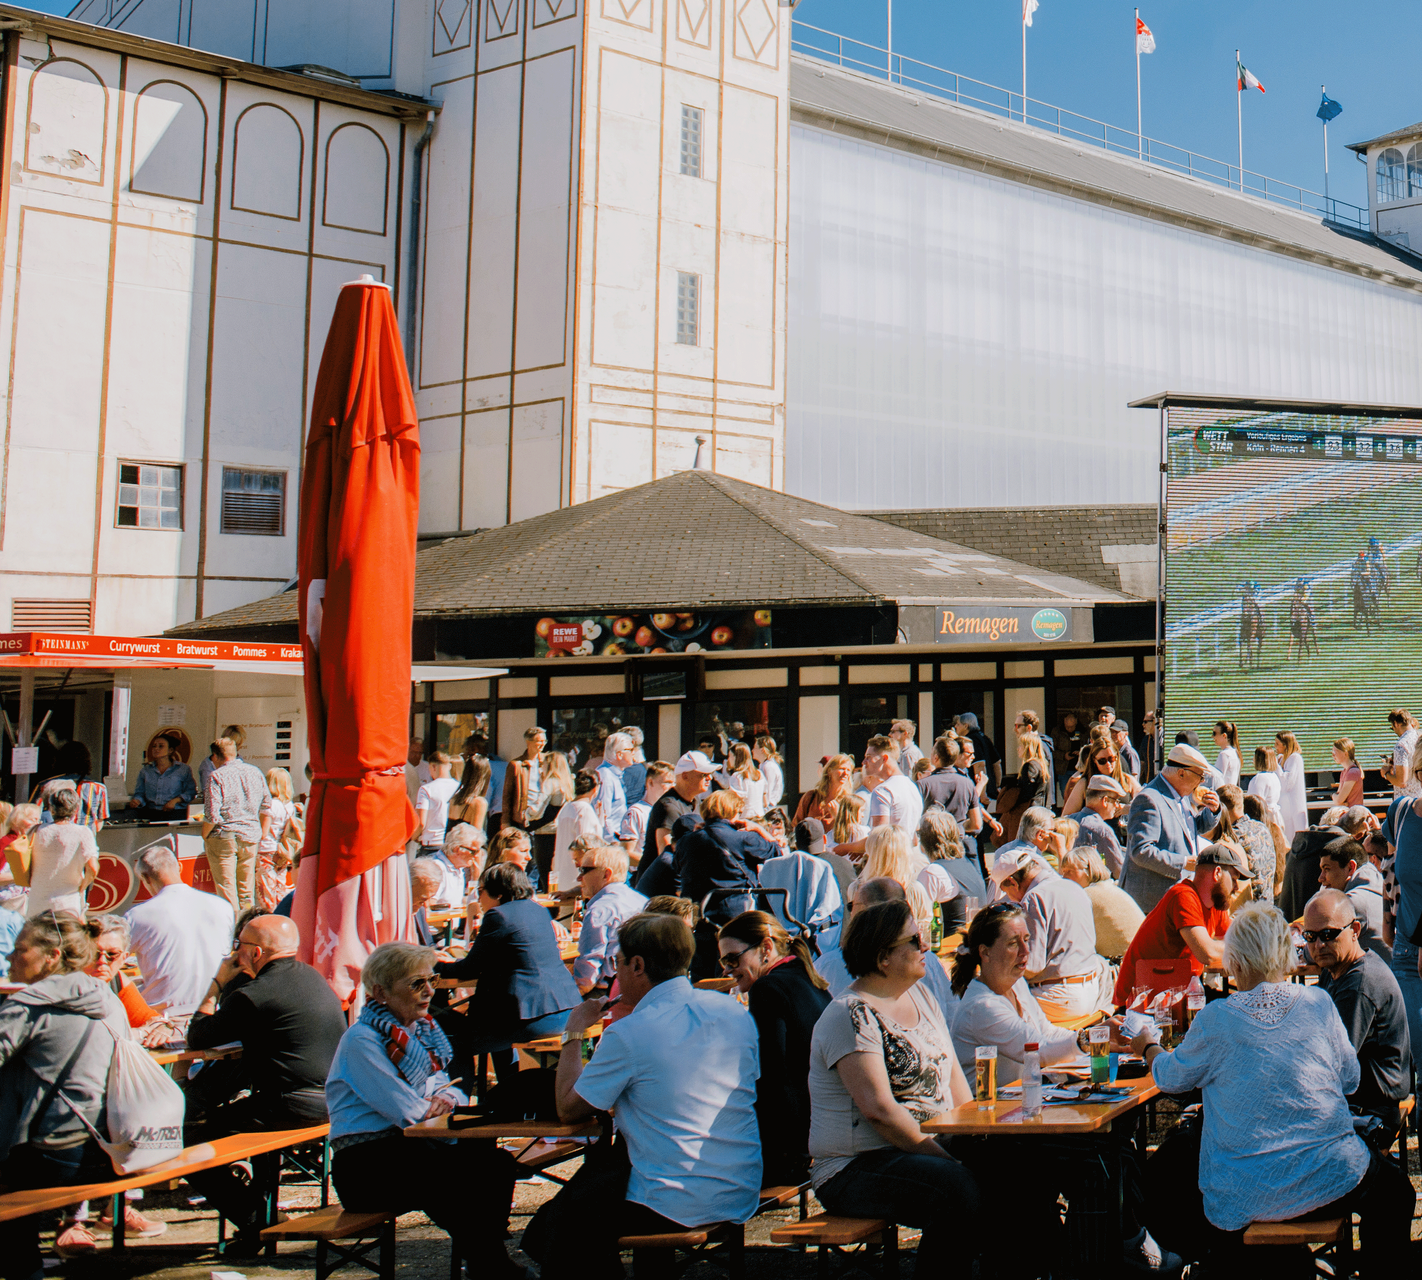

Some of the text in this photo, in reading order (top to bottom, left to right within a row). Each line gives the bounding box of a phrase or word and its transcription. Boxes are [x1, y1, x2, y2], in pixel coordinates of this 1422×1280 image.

[1202, 430, 1229, 440] WETT
[1209, 441, 1234, 452] STAR
[940, 610, 1018, 641] Remagen
[1035, 620, 1063, 632] Remagen
[553, 628, 578, 636] REWE
[109, 640, 160, 654] Currywurst
[176, 643, 218, 656] Bratwurst
[233, 646, 267, 657] Pommes
